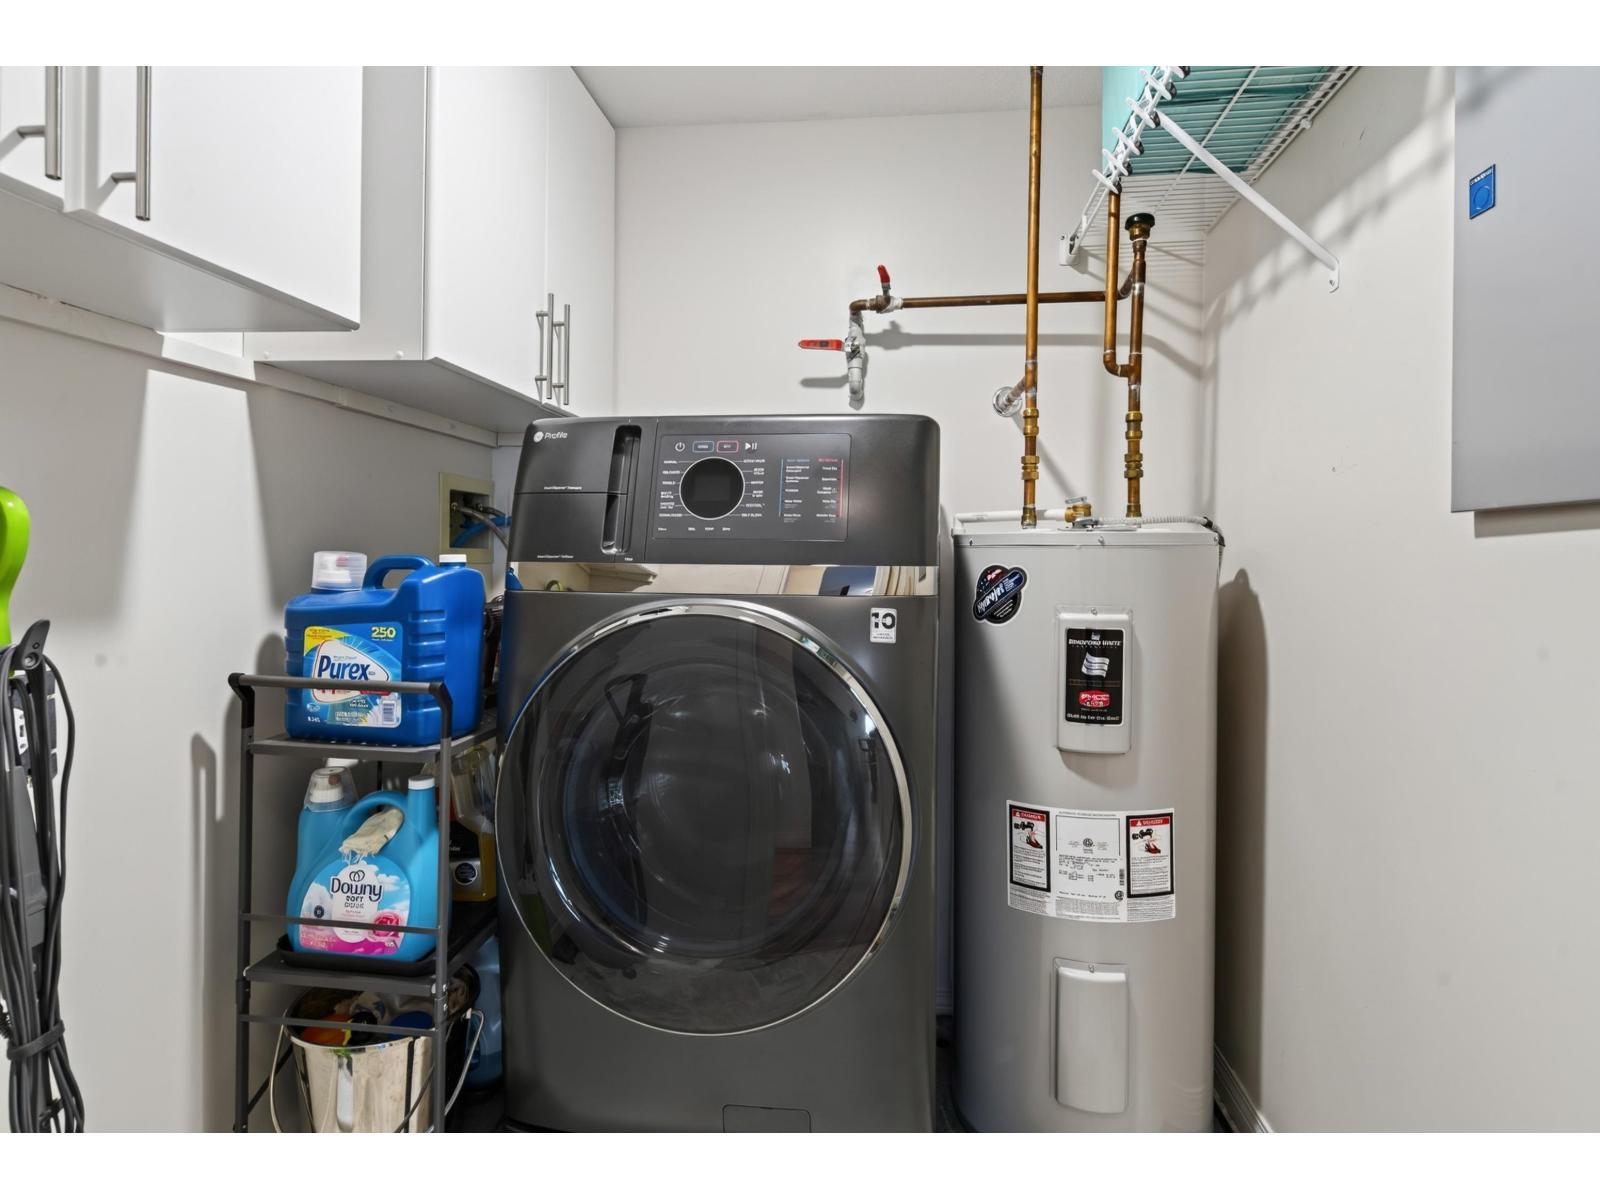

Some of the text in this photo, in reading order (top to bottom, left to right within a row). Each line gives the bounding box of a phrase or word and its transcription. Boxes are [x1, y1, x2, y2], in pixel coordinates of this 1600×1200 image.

[871, 612, 896, 629] 10
[370, 626, 397, 639] 250
[318, 655, 371, 680] Purex
[331, 877, 382, 902] Downy
